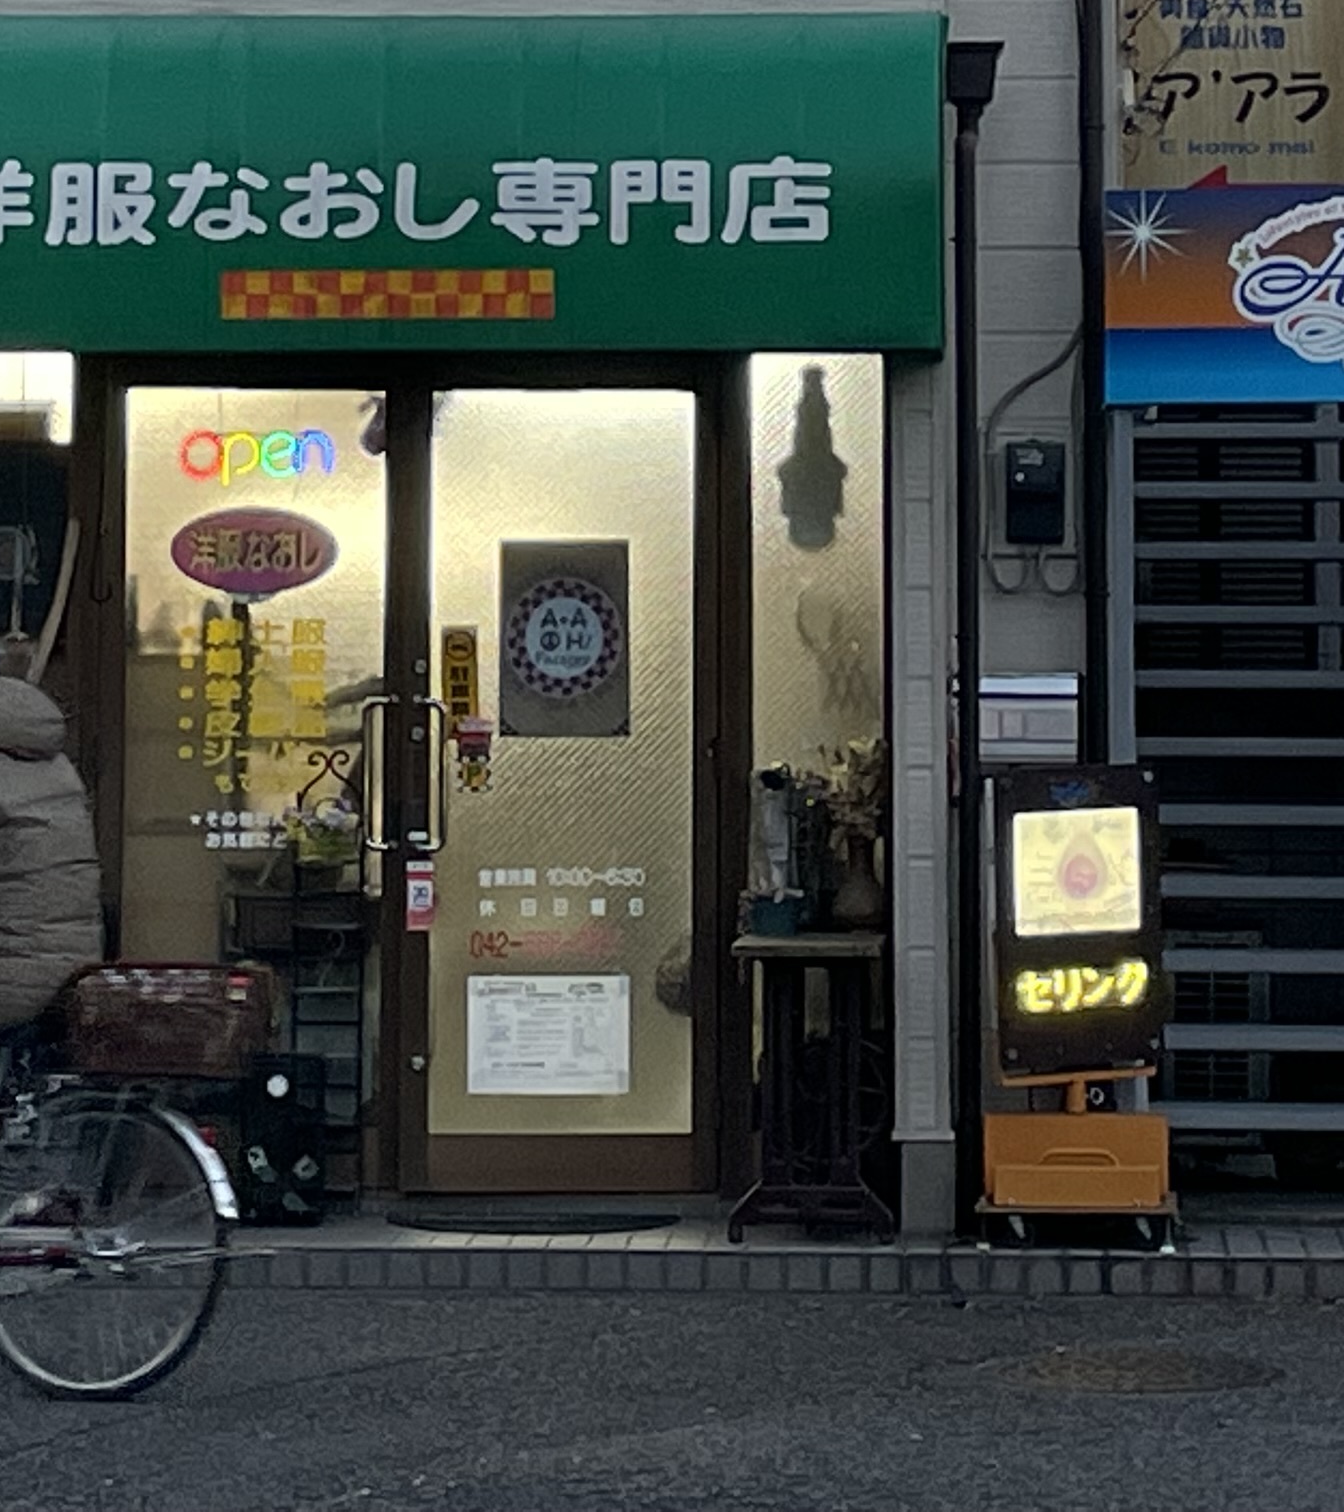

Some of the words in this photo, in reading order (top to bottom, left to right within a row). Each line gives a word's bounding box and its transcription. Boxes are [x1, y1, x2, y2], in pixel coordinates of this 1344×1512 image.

[179, 428, 336, 487] open
[188, 528, 322, 574] 洋服なおし
